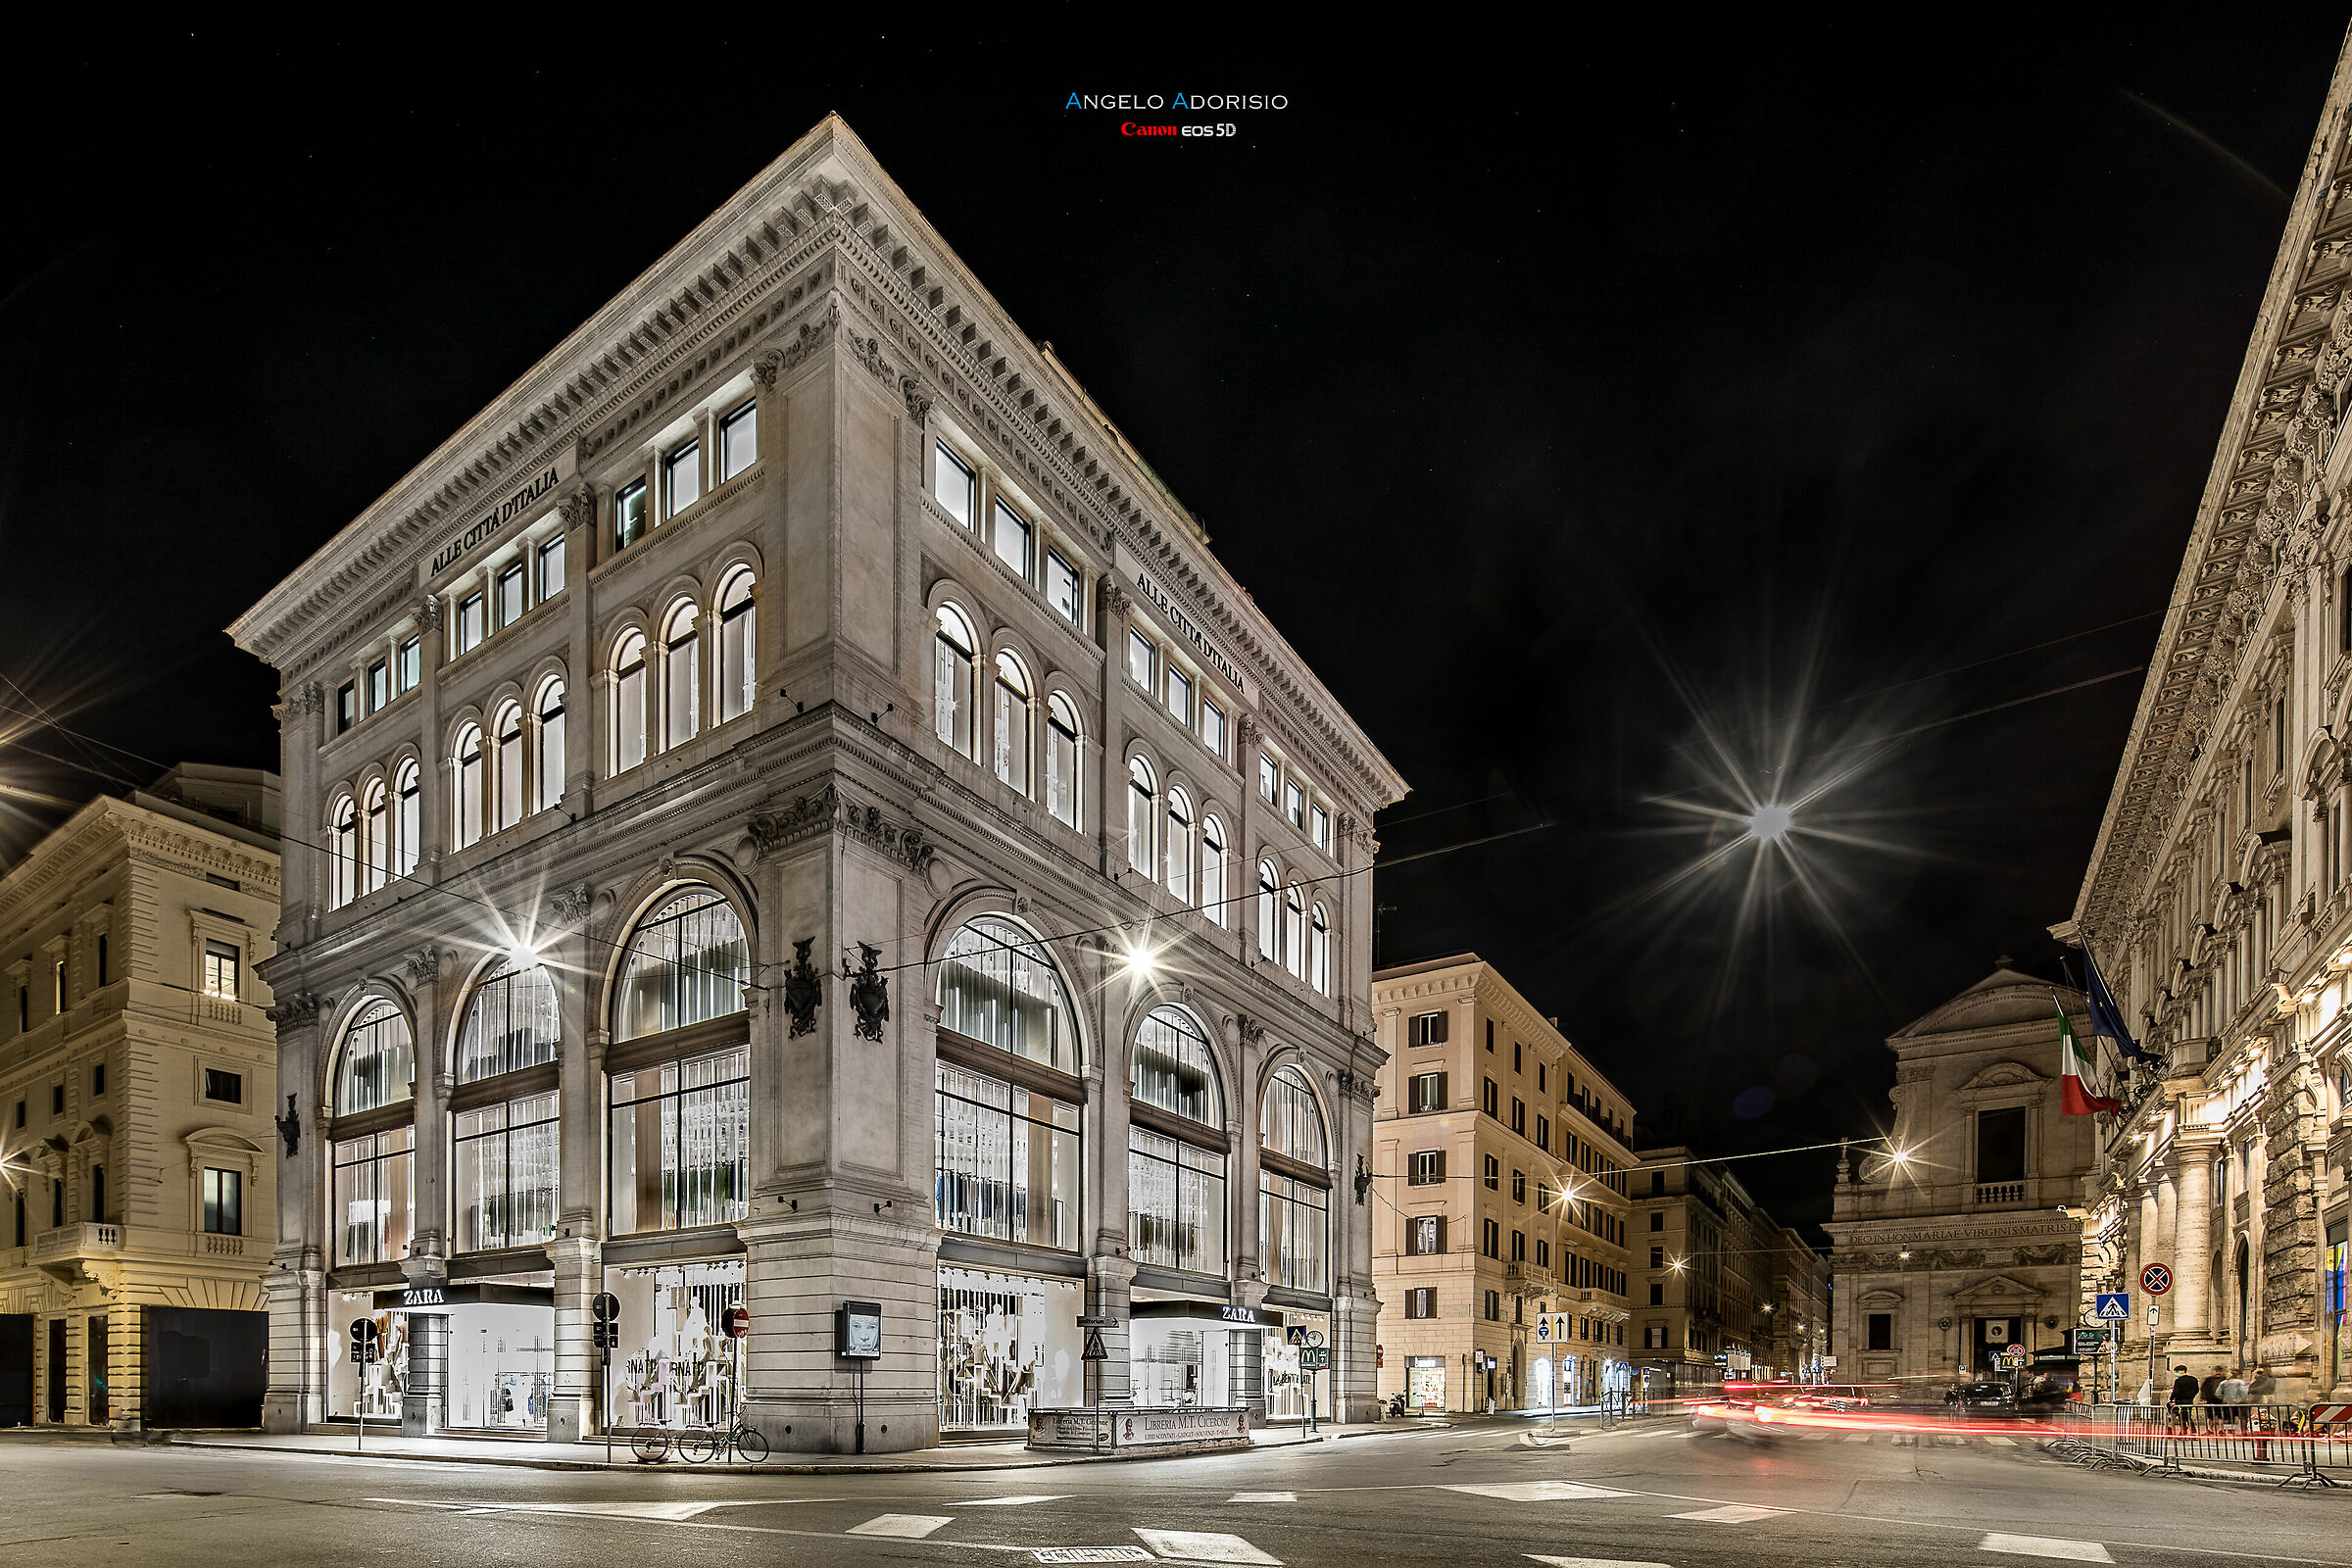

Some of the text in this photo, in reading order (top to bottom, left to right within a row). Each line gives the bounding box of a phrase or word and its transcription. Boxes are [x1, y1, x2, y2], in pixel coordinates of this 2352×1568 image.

[430, 540, 462, 577] ALLE
[501, 466, 560, 523] D'ITALIA
[1137, 572, 1168, 615] ALLE
[1964, 1226, 2019, 1238] VIRGINIS
[2020, 1222, 2066, 1235] MATRIS
[403, 1289, 445, 1305] ZARA
[1222, 1305, 1256, 1323] ZARA
[1144, 1414, 1230, 1431] LIBRERIA M.T. CICERONE
